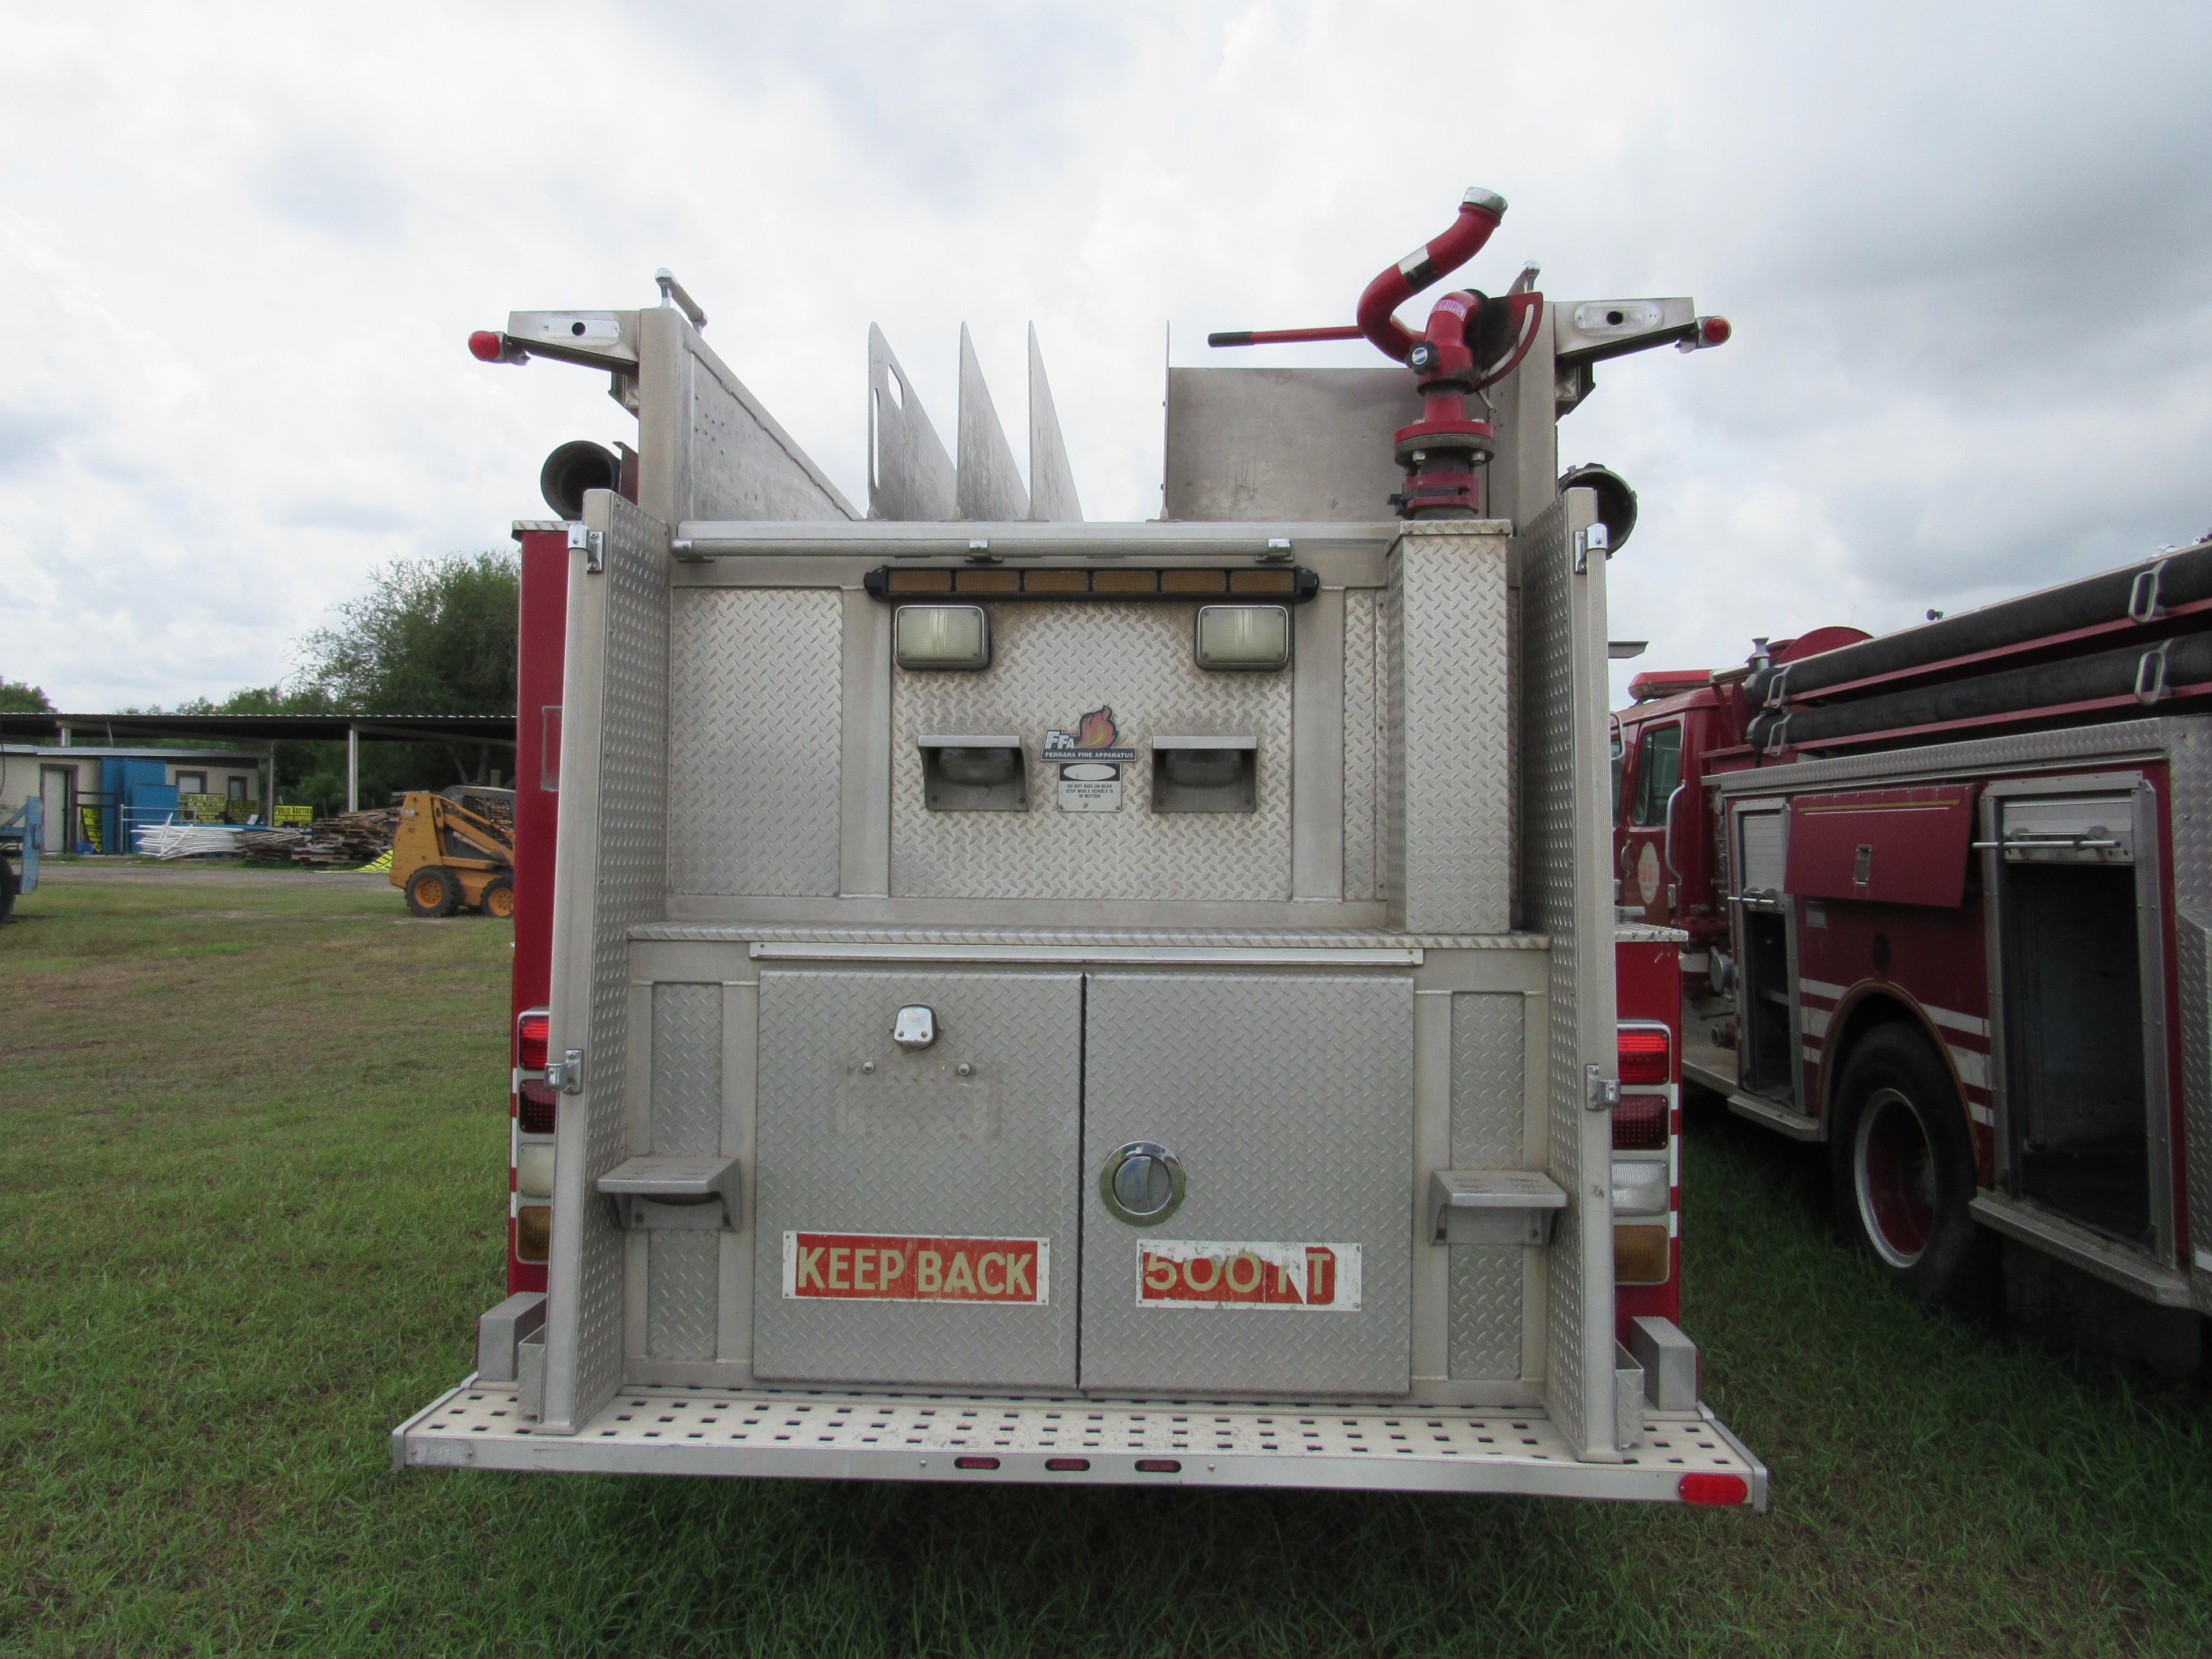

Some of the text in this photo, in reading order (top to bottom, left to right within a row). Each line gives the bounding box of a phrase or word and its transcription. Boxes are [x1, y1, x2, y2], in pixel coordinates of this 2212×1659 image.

[1044, 730, 1074, 749] FFA
[798, 1247, 1033, 1295] KEEP BACK
